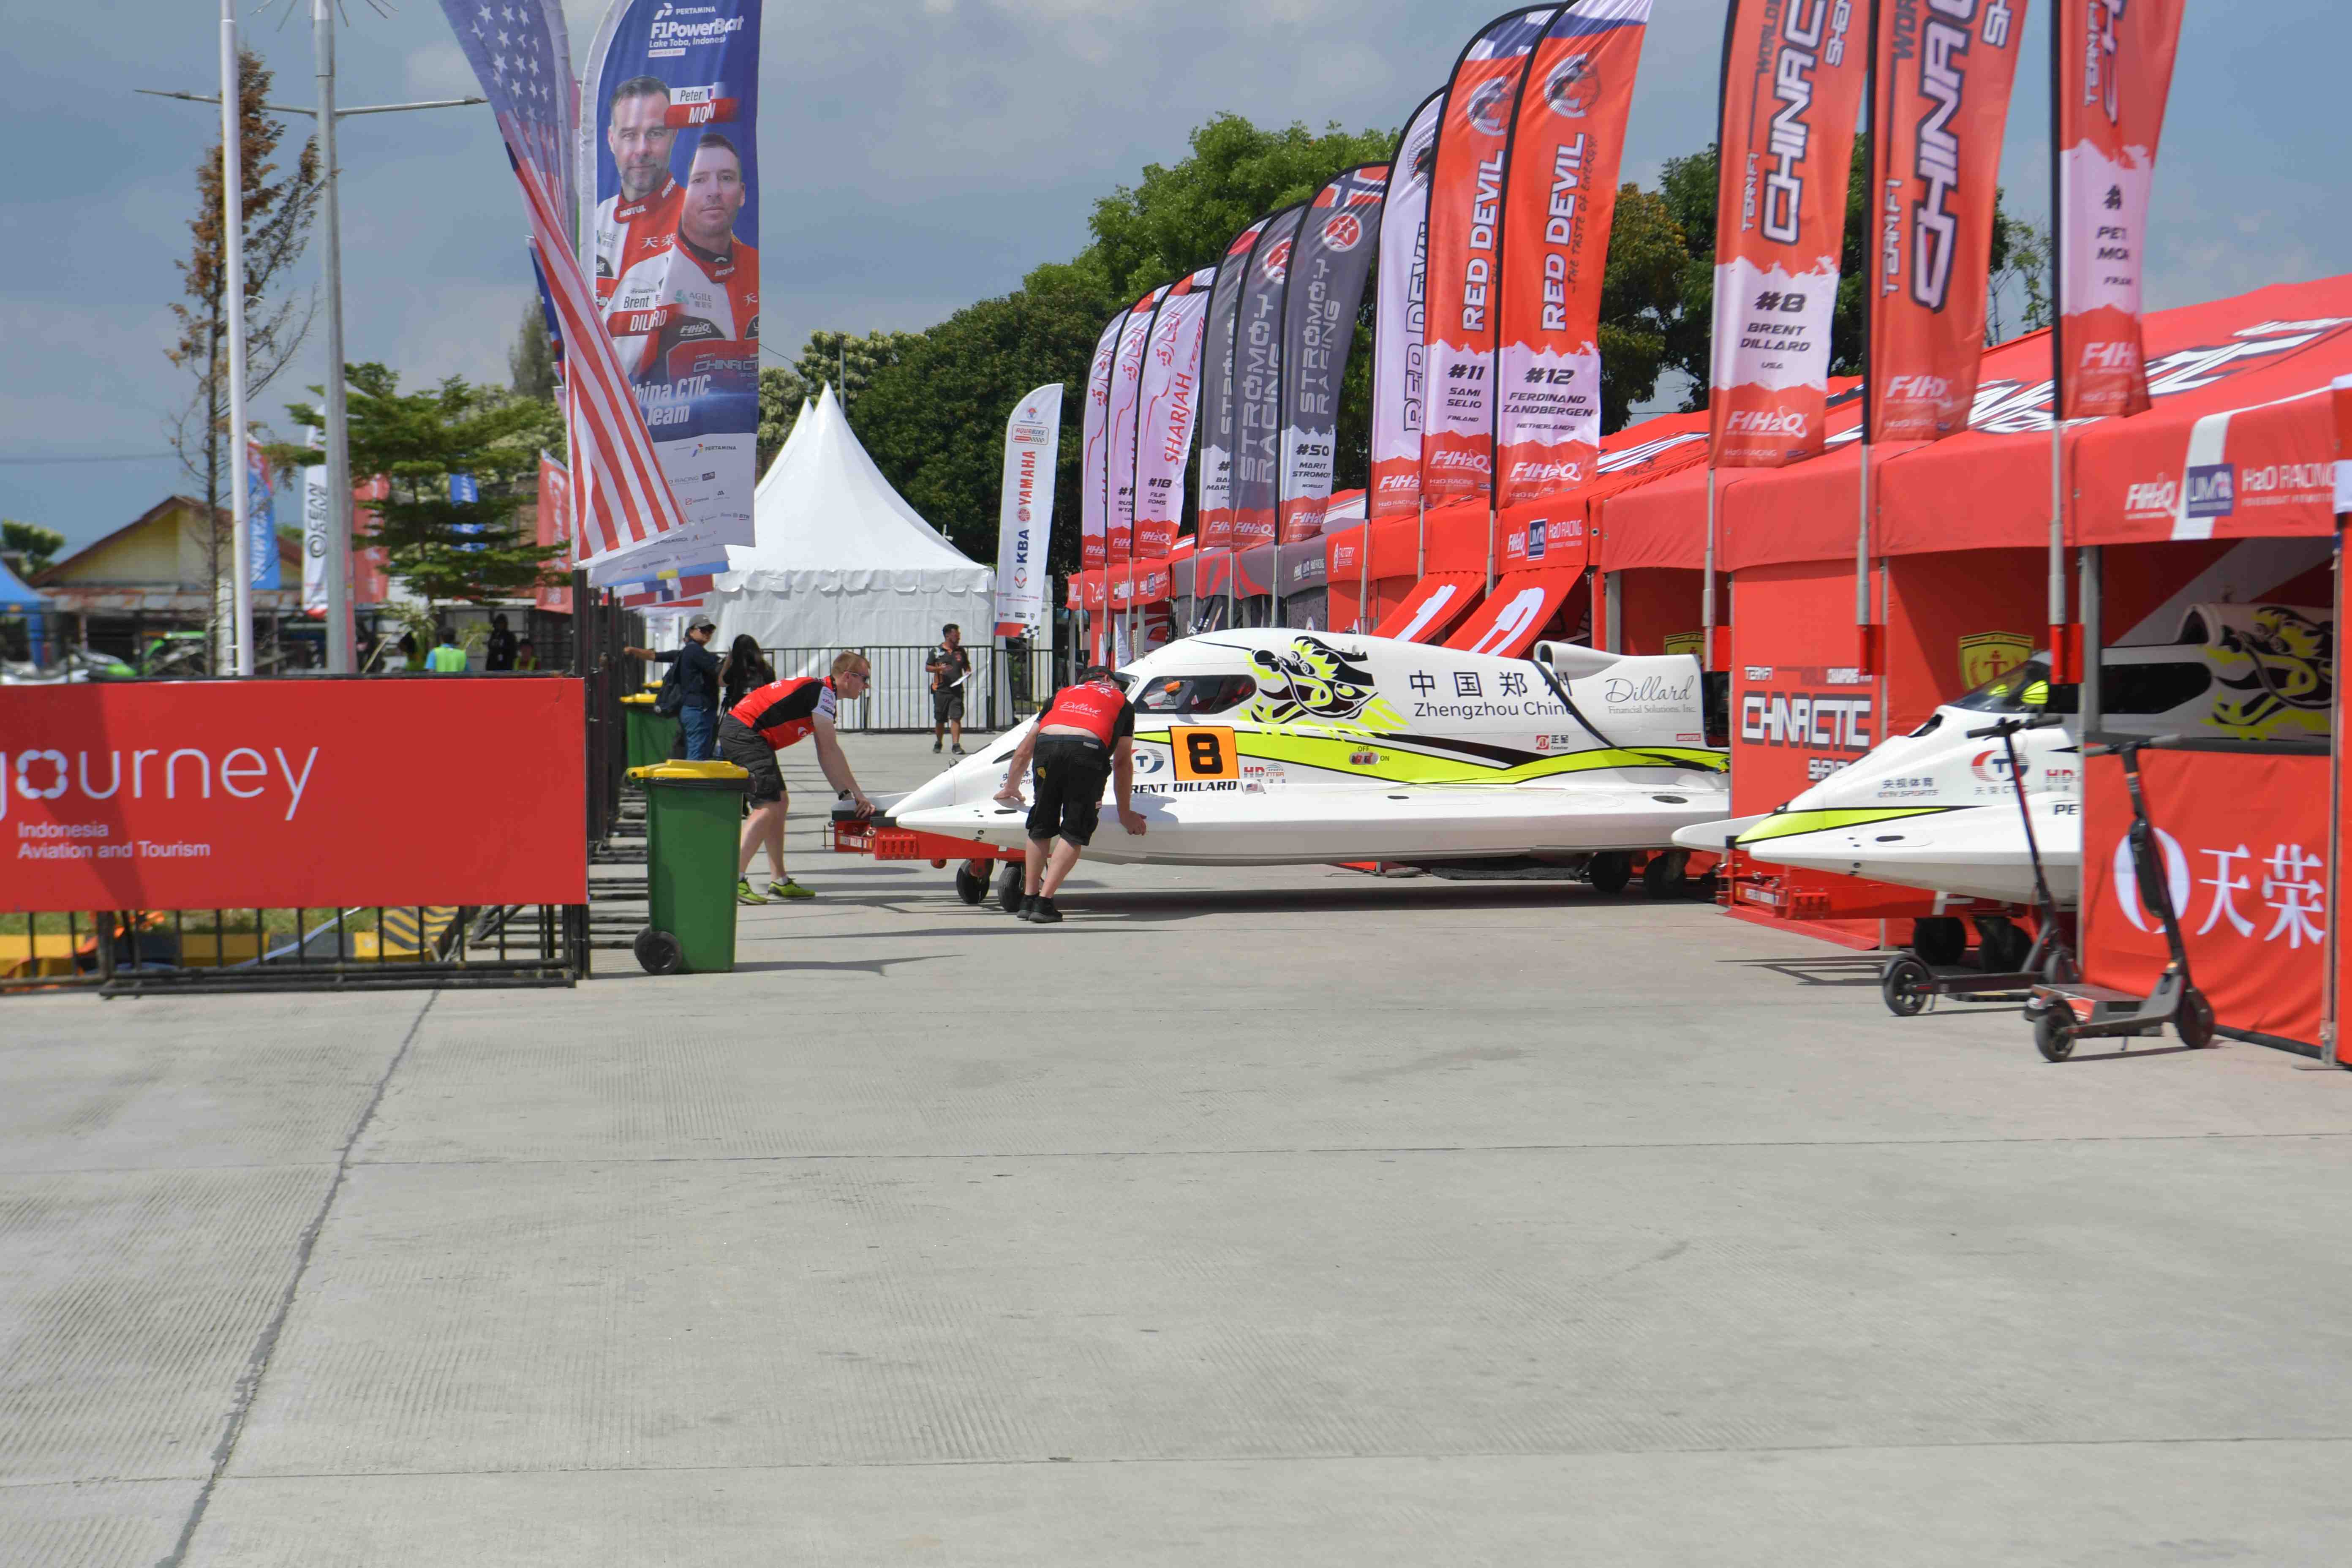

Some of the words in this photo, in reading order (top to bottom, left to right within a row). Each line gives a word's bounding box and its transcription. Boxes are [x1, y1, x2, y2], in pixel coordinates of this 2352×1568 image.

[676, 6, 716, 15] PERTAMINA
[649, 40, 668, 48] Lake
[670, 38, 691, 47] Toba,
[693, 35, 727, 45] Indonesi
[680, 90, 703, 102] Peter
[1545, 132, 1586, 246] DEVIL
[1470, 149, 1505, 251] DEVIL
[619, 205, 647, 218] MOTUL
[1571, 215, 1586, 255] TASTE
[1579, 194, 1589, 212] OF
[689, 292, 713, 302] AGILE
[1462, 258, 1490, 332] RED
[1540, 253, 1567, 331] RED
[623, 296, 650, 309] Brent
[1754, 291, 1808, 313] #8
[1747, 322, 1808, 336] BRENT
[1739, 338, 1812, 352] DILLARD
[1448, 364, 1485, 380] #11
[1761, 361, 1784, 369] USA
[1524, 367, 1576, 386] #12
[633, 381, 672, 404] hina
[676, 374, 711, 397] CTIC
[1448, 387, 1481, 397] SAMI
[1446, 399, 1482, 409] SELIO
[1508, 392, 1587, 404] FERDINAND
[647, 405, 690, 426] Team
[1164, 372, 1192, 465] SHARJAH
[1502, 404, 1594, 417] ZANDBERGEN
[1516, 423, 1576, 432] NETHERLANDS
[1726, 406, 1808, 438] F1H2O
[1296, 444, 1329, 456] #50
[1018, 451, 1035, 505] YAMAHA
[1378, 472, 1420, 490] F1H2
[2241, 466, 2278, 491] H2O
[1016, 529, 1030, 563] KBA
[1605, 675, 1694, 703] Dillard
[1059, 701, 1102, 714] Dillard
[1414, 701, 1519, 720] Zhengzhou
[1608, 705, 1642, 714] Financial
[1187, 733, 1223, 774] 8
[1243, 766, 1265, 778] HD
[1131, 783, 1168, 794] RENT
[1173, 781, 1237, 792] DILLARD
[1882, 777, 1935, 789] 央视体育
[17, 822, 109, 838] Indonesia
[17, 840, 93, 859] Aviation
[98, 840, 132, 859] and
[140, 839, 211, 858] Tourism
[2196, 844, 2326, 949] 天荣
